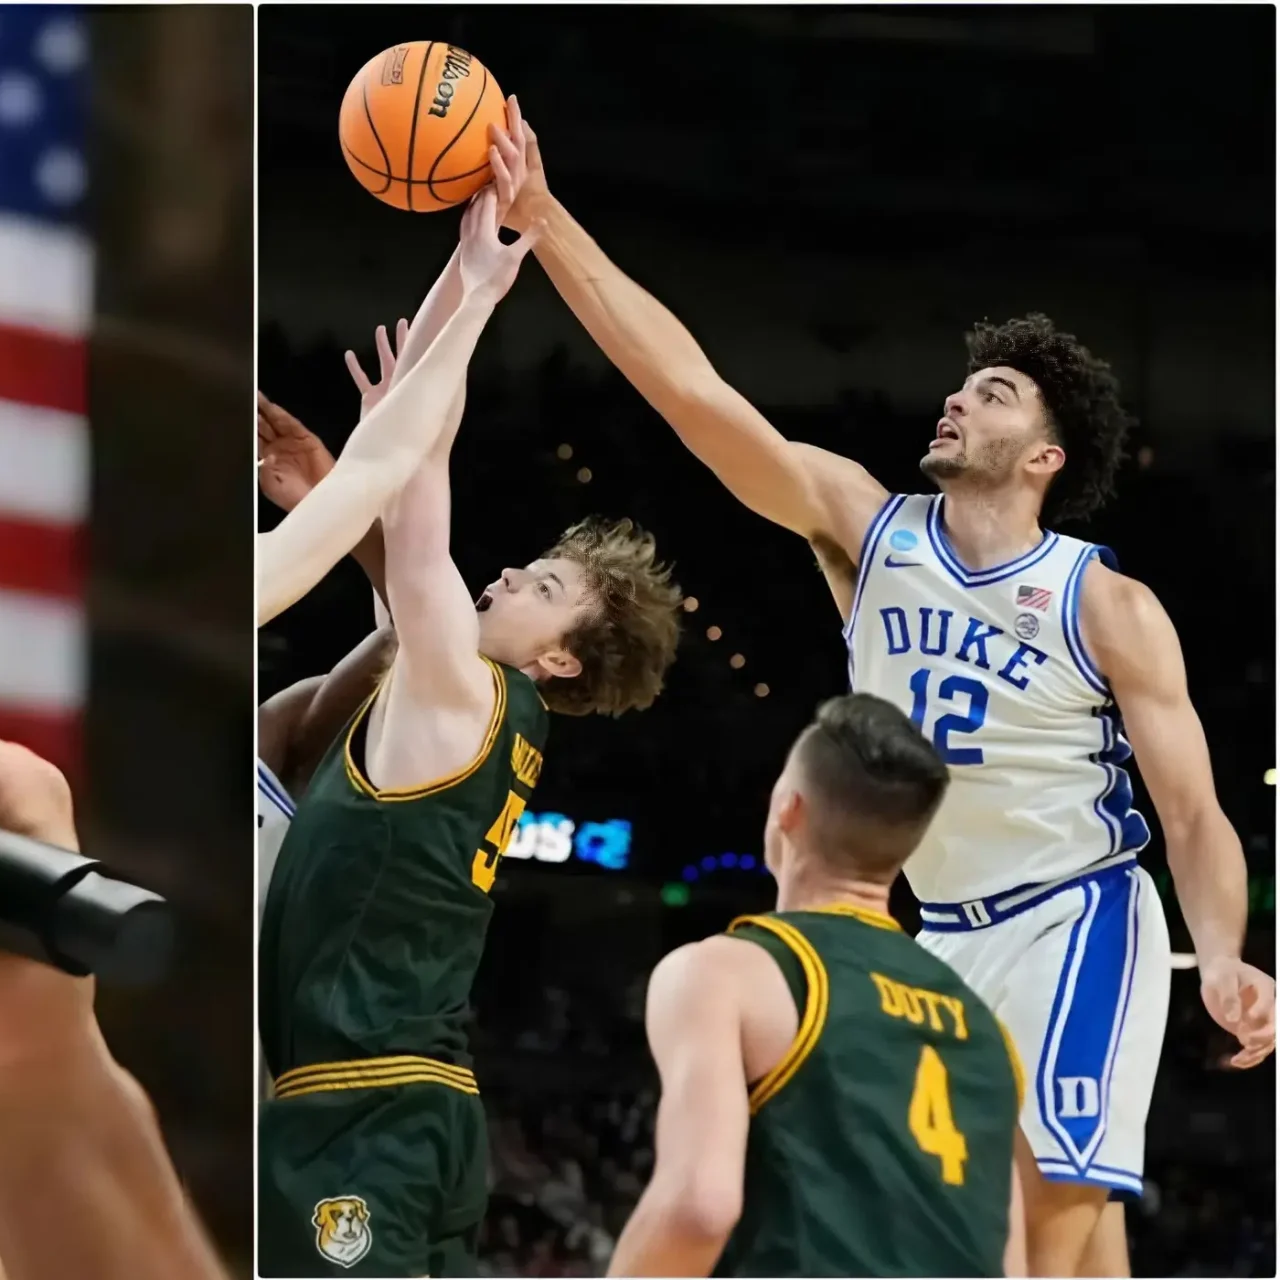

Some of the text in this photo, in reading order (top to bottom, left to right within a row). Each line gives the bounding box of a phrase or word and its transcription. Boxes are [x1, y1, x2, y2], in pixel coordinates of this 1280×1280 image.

[878, 606, 1048, 691] DUKE
[909, 667, 990, 765] 12
[869, 971, 969, 1040] DOTY
[907, 1044, 969, 1187] 4
[1056, 1076, 1100, 1118] D
